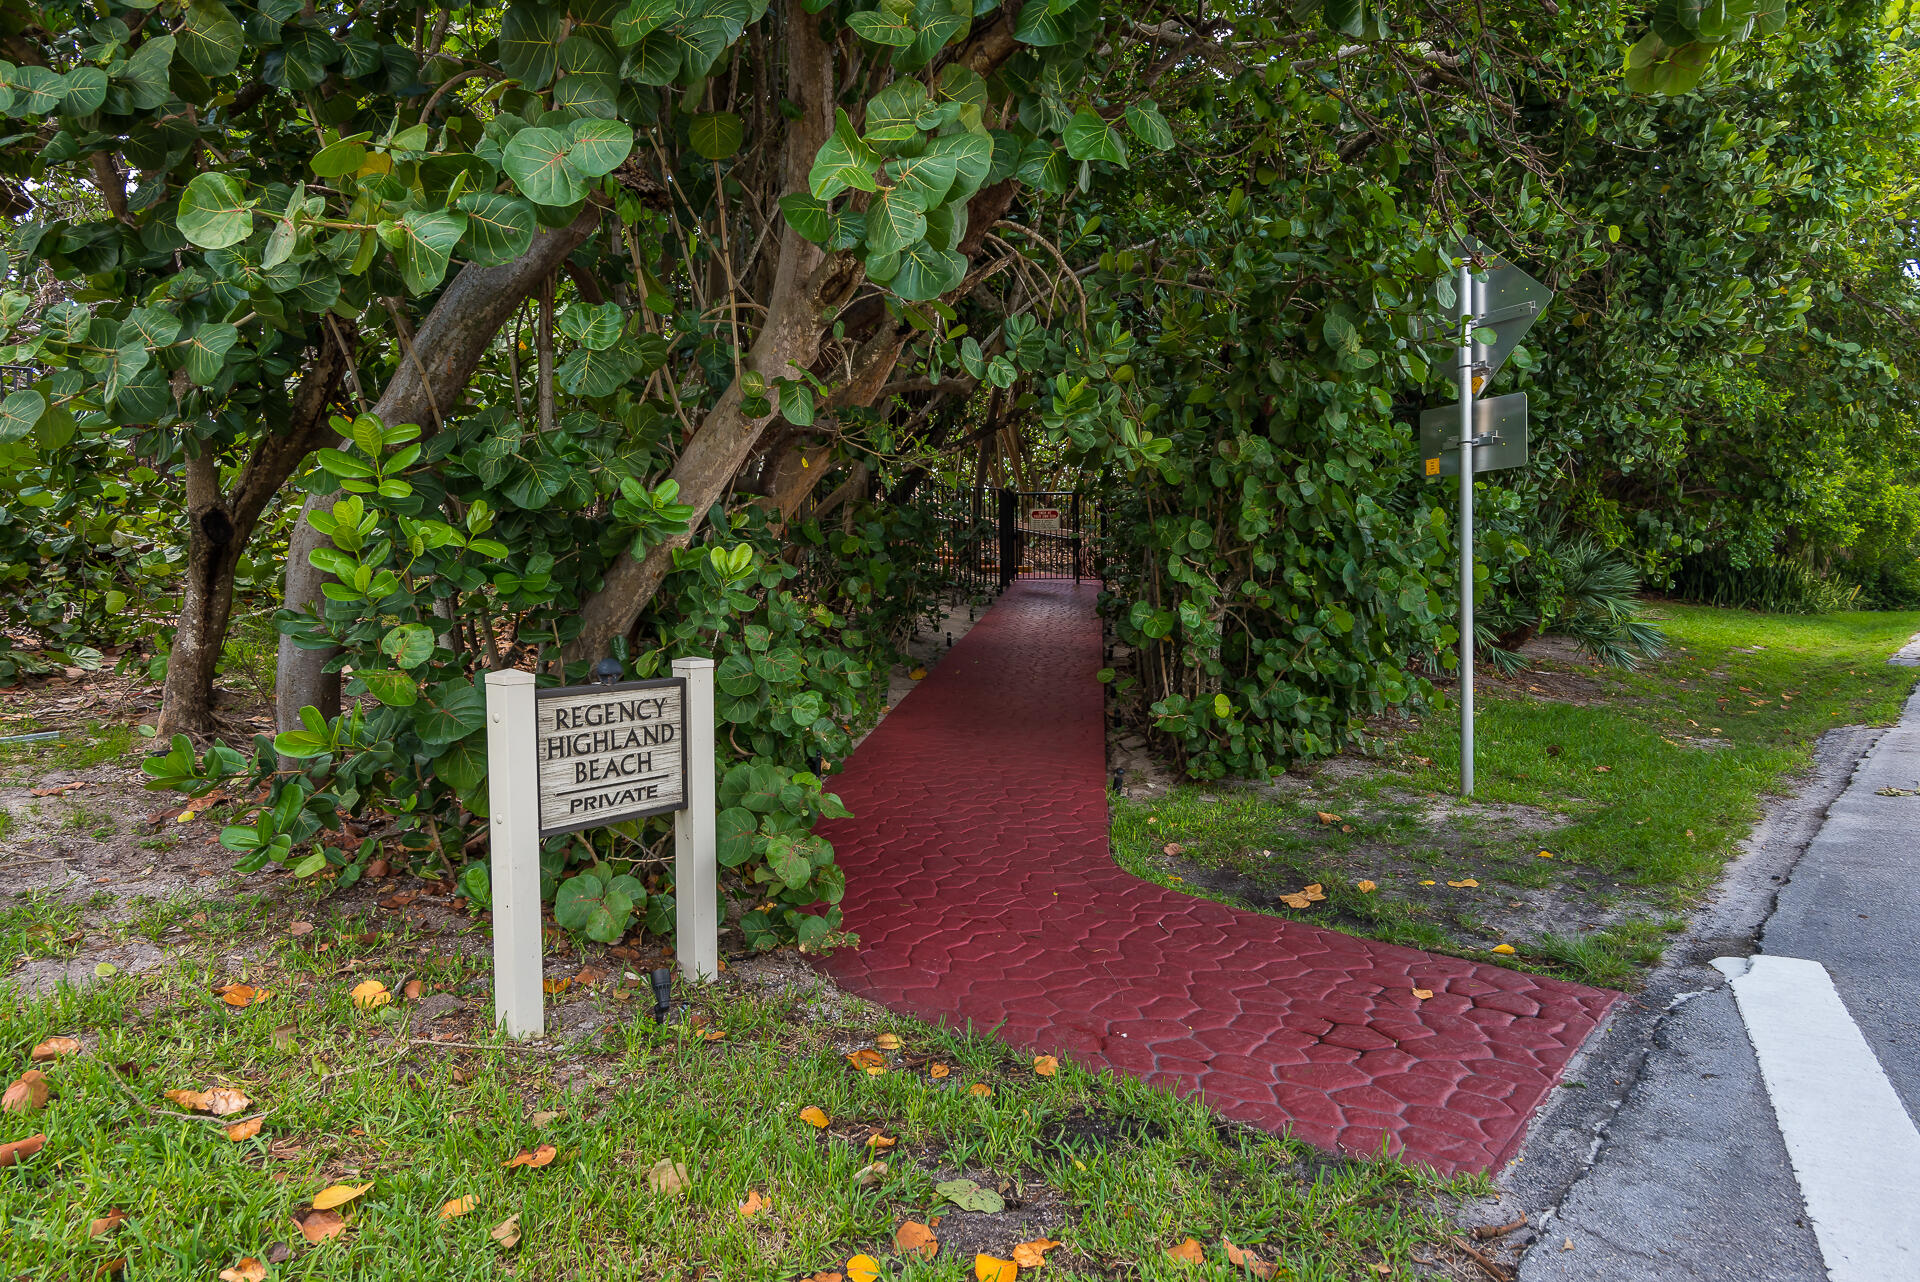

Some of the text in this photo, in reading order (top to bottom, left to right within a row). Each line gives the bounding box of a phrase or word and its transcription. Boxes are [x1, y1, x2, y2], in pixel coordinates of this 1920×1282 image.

[555, 697, 666, 730] REGENCY
[546, 724, 675, 760] HIGHLAND
[574, 751, 653, 784] BEACH
[569, 784, 659, 814] PRIVATE
